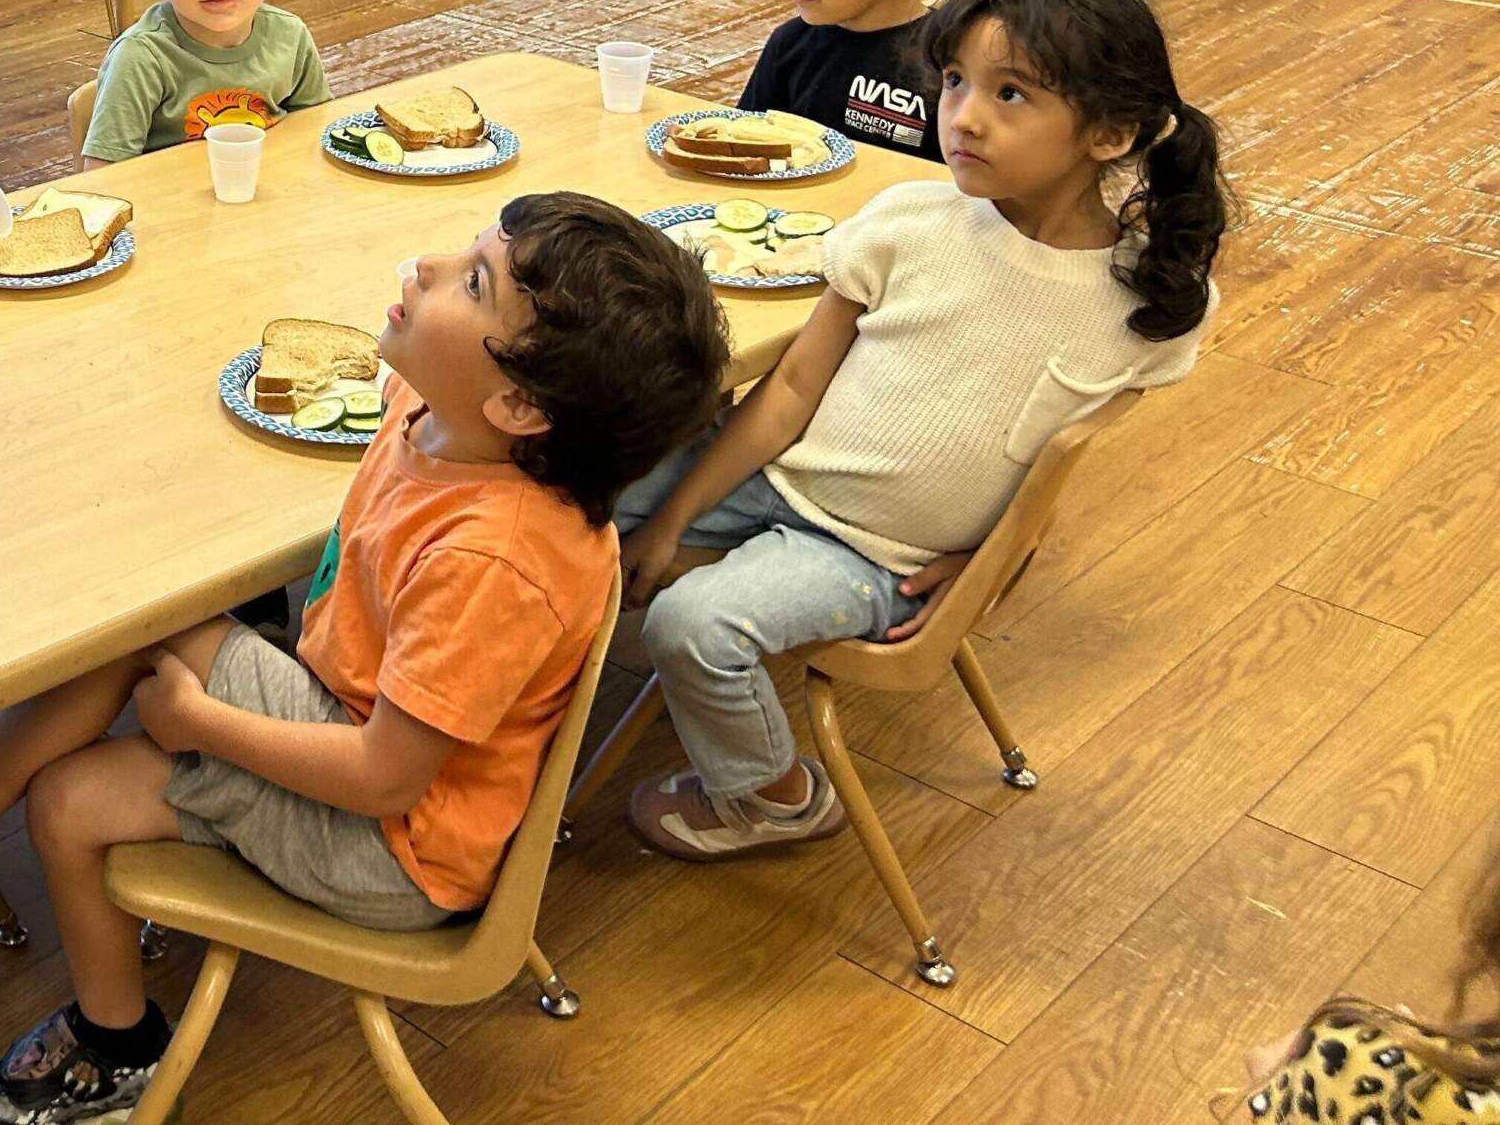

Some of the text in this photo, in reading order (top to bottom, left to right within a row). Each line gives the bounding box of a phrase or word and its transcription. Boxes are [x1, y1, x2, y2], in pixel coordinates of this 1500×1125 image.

[849, 75, 926, 122] NASA
[844, 107, 895, 132] KENNEDY
[844, 117, 864, 131] SPACE
